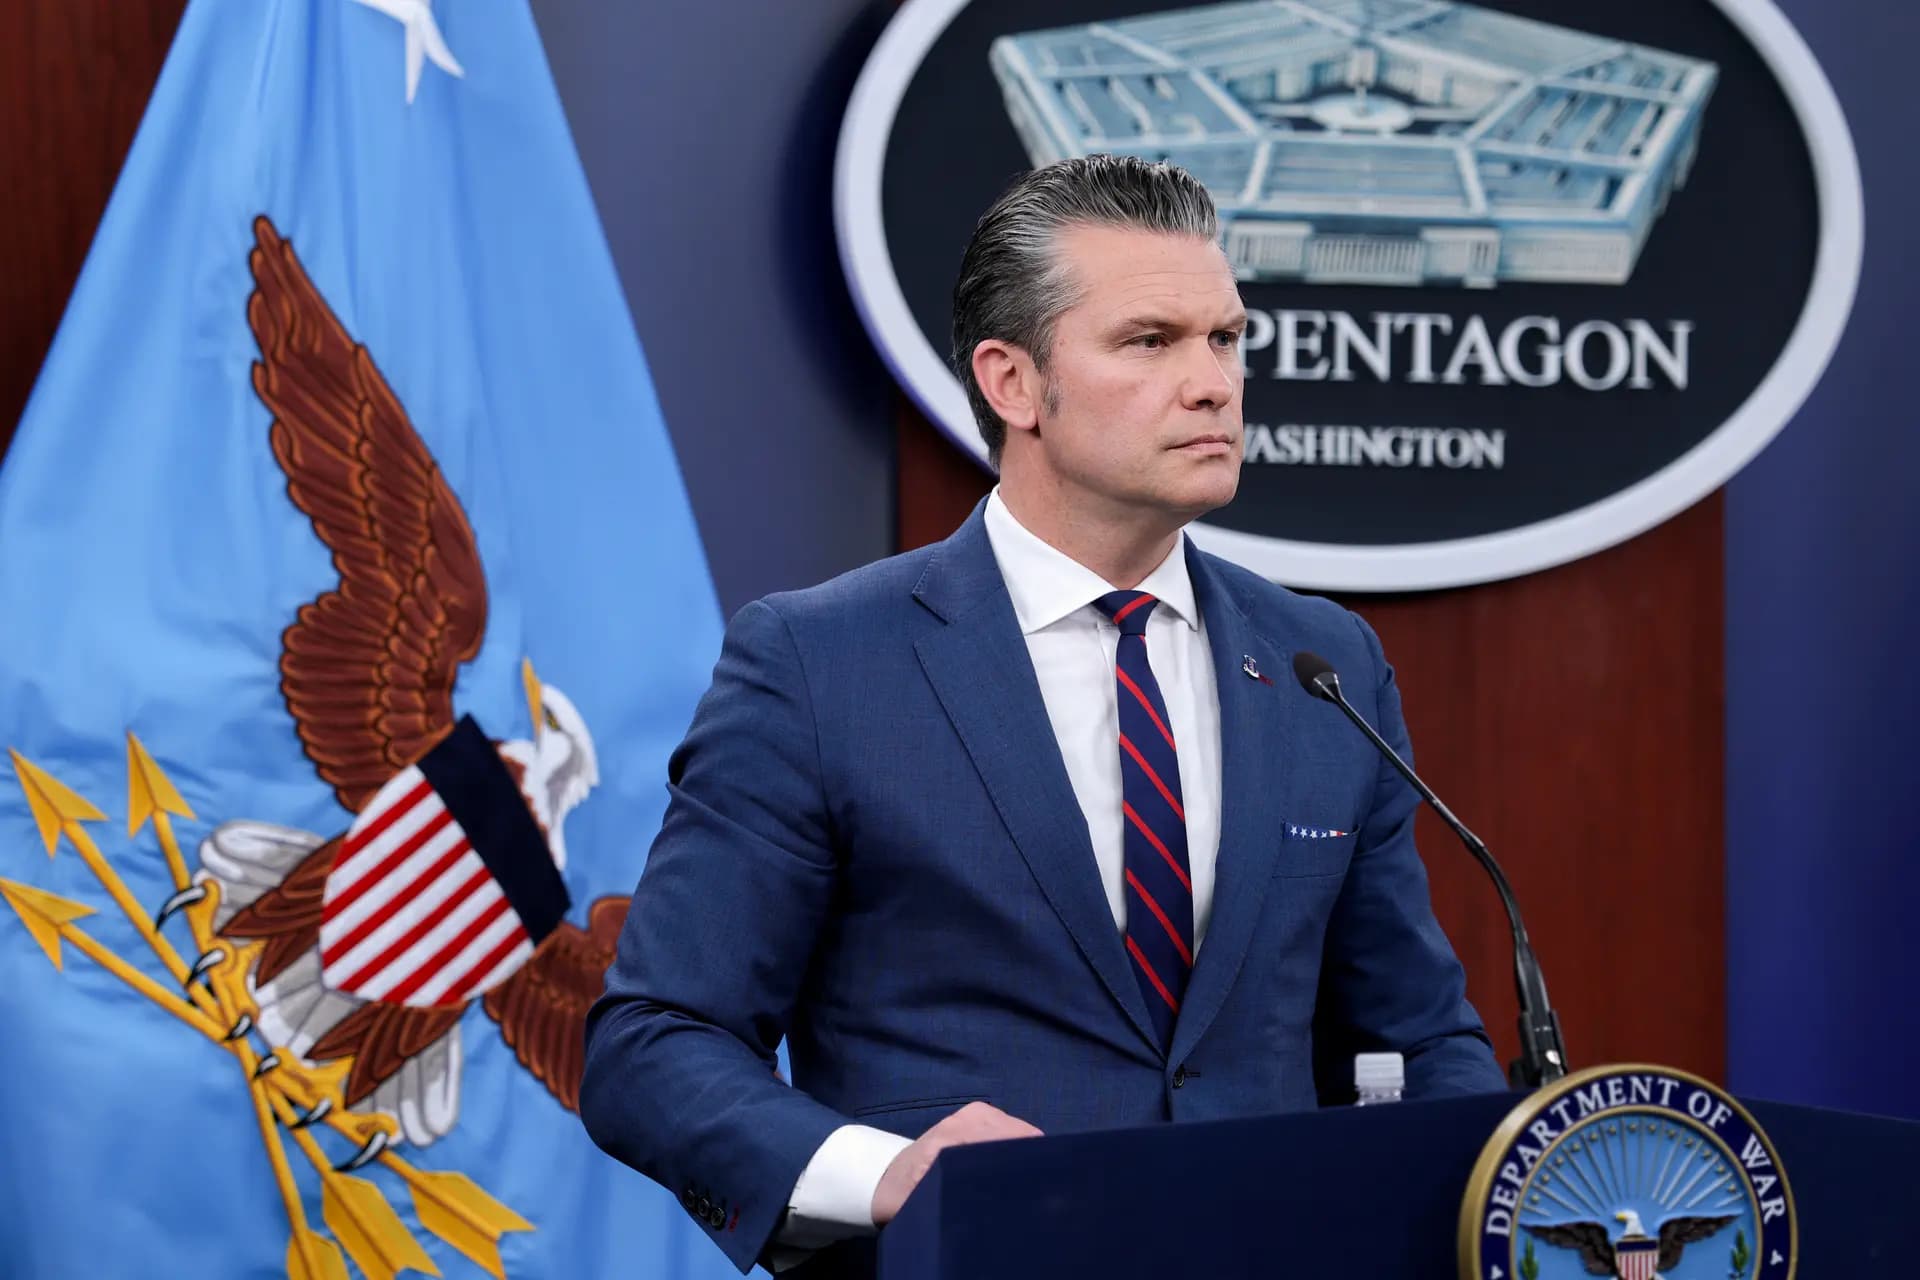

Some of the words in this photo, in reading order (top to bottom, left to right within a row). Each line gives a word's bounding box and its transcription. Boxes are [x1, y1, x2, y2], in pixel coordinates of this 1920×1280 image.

[1239, 308, 1694, 392] PENTAGON
[1486, 1075, 1680, 1237] DEPARTMENT
[1687, 1091, 1733, 1128] OF
[1741, 1134, 1786, 1225] WAR
